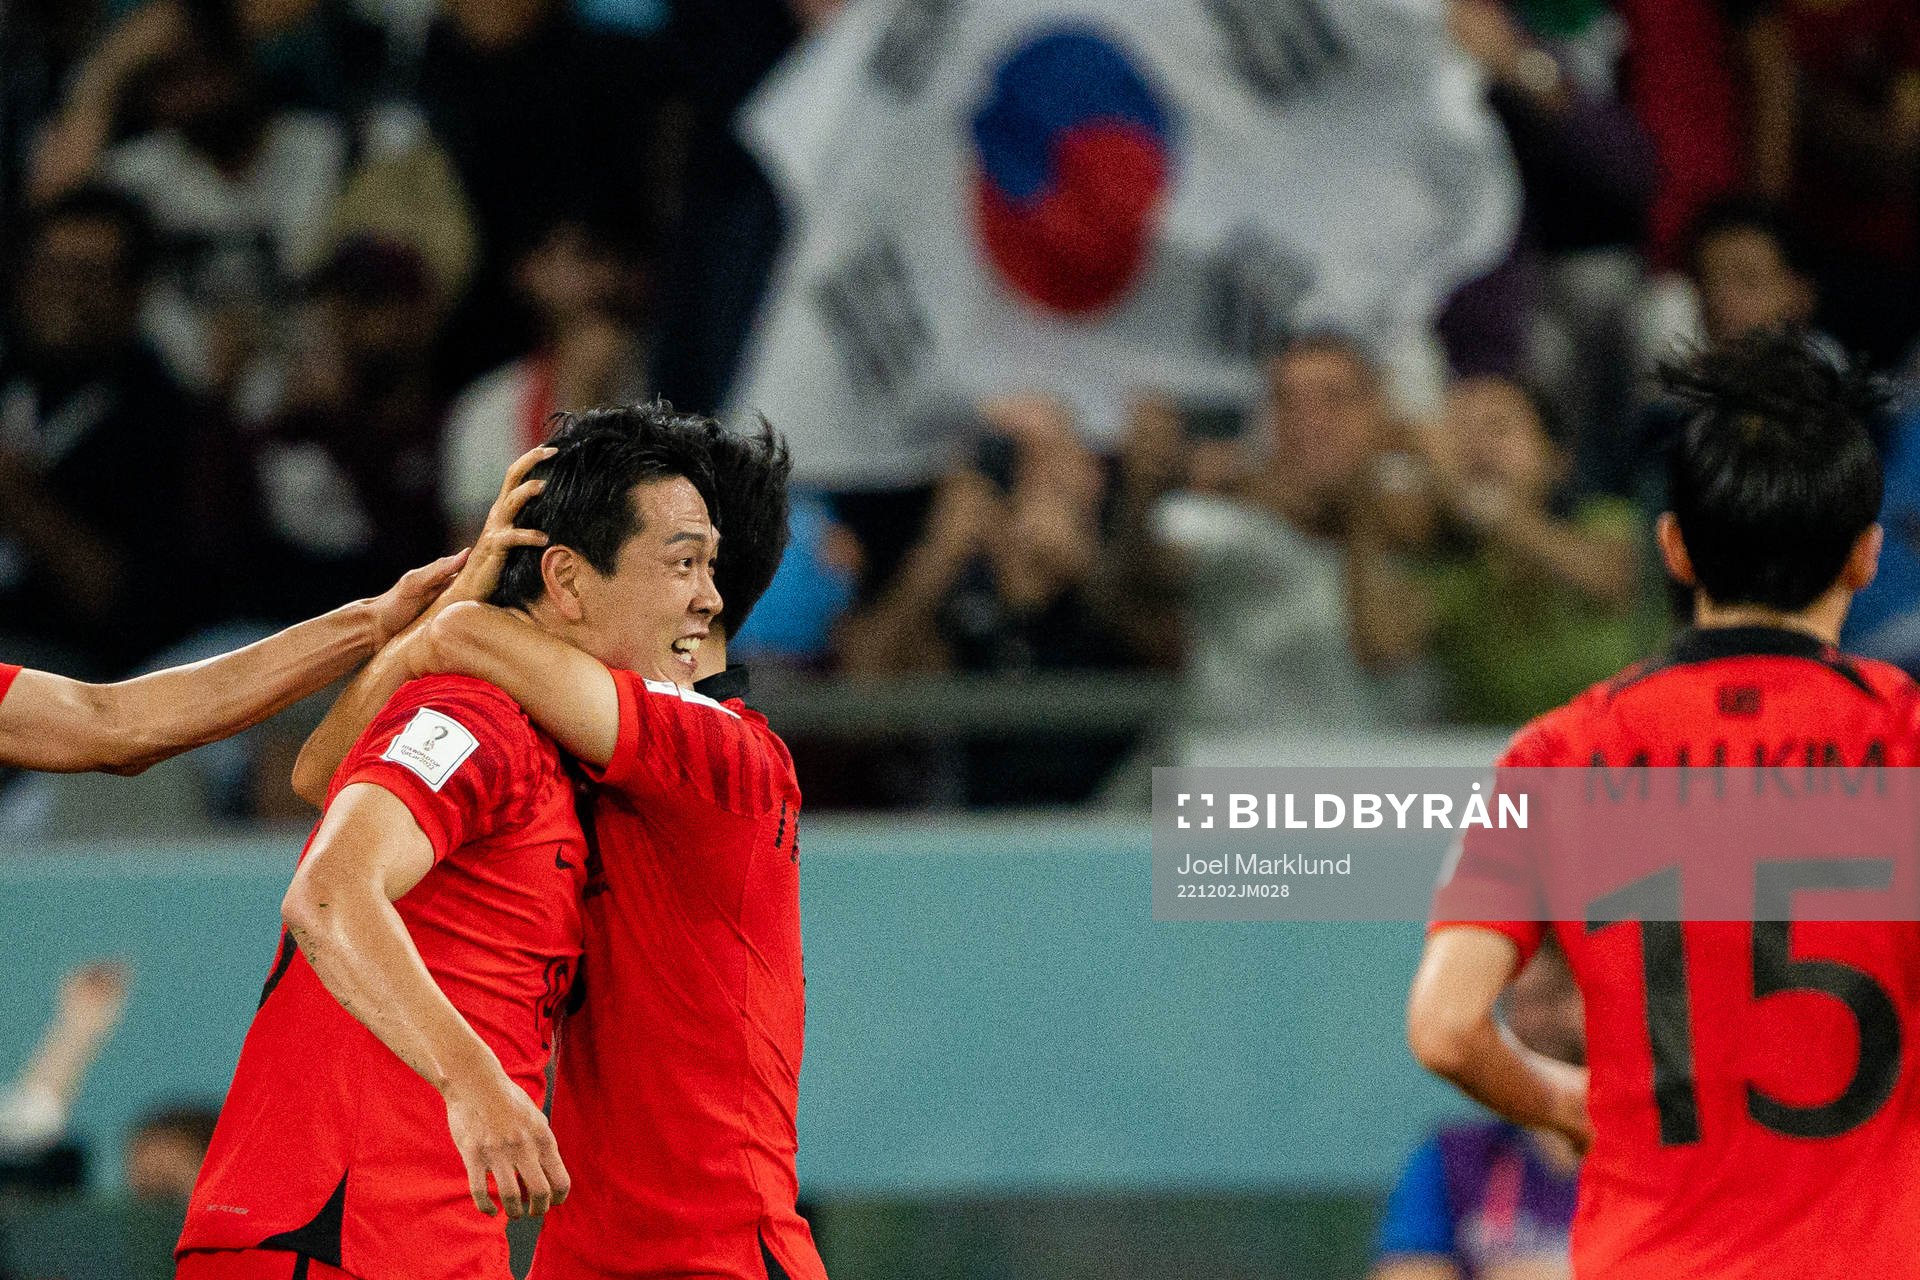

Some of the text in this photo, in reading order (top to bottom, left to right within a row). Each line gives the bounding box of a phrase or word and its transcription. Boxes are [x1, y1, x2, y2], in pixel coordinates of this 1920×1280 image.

[1584, 736, 1886, 804] M H KIM
[1584, 857, 1903, 1147] 15
